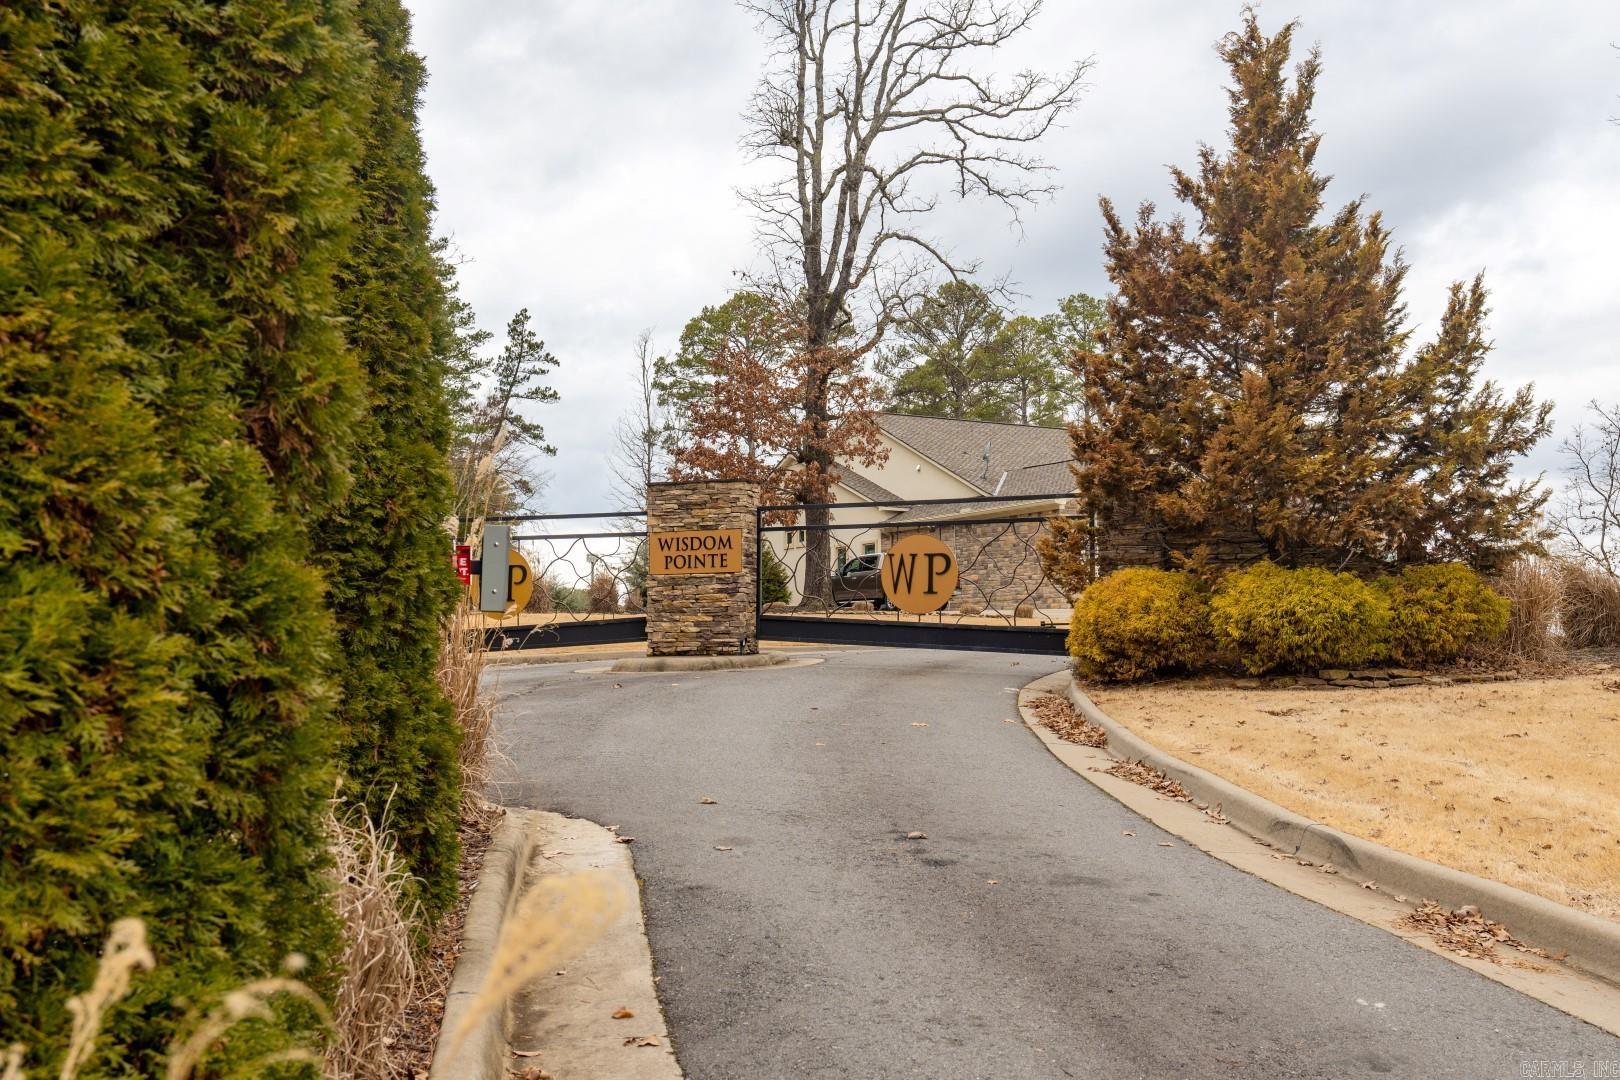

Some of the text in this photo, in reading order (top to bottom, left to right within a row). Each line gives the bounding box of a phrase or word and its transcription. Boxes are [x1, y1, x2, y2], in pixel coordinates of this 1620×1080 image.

[657, 535, 733, 552] WISDOM
[664, 553, 728, 570] POINTE
[887, 552, 952, 595] WP
[506, 564, 528, 602] P
